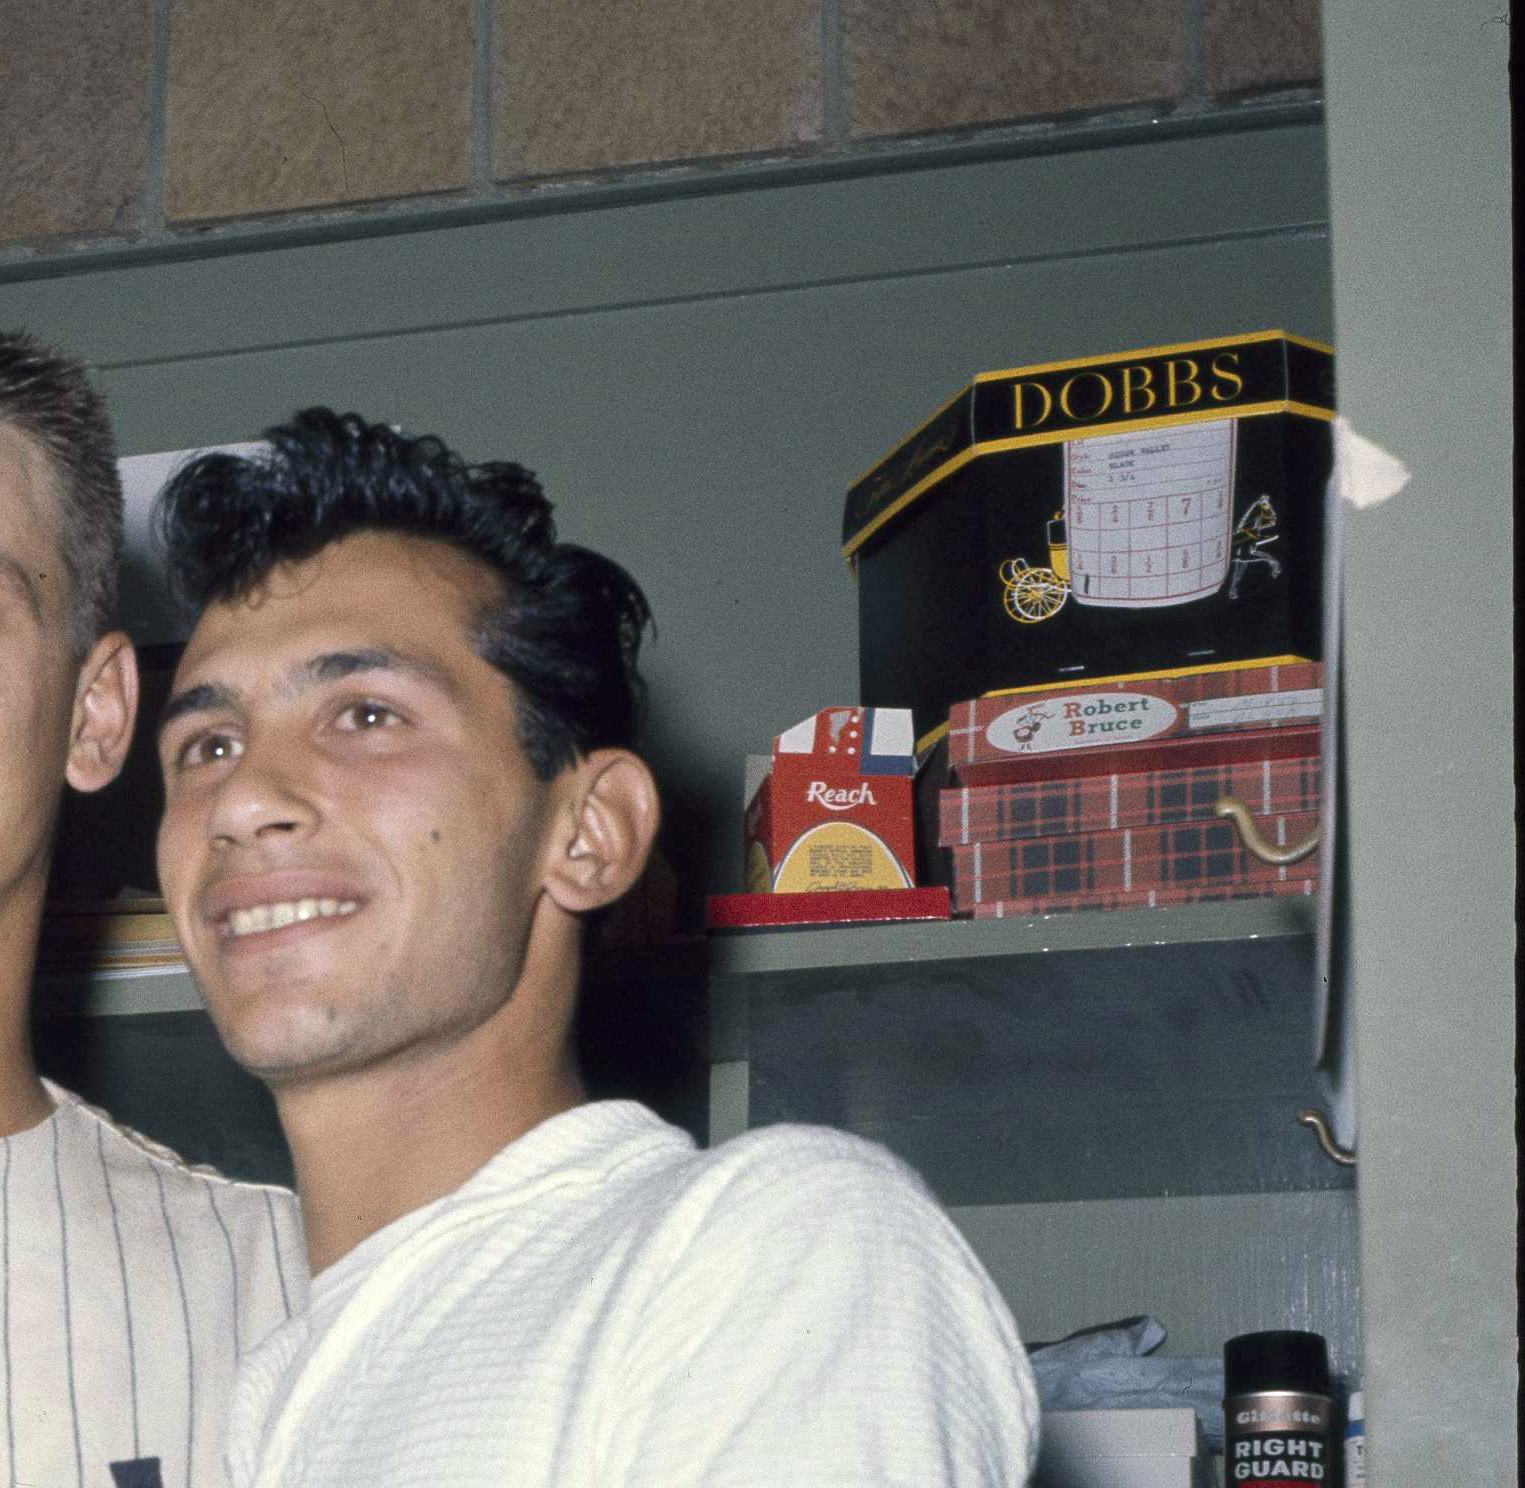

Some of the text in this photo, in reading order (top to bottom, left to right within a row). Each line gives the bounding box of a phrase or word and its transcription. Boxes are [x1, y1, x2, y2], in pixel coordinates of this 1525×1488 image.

[1011, 352, 1244, 430] DOBBS
[1062, 696, 1151, 720] Robert
[1068, 715, 1144, 738] Bruce
[806, 781, 878, 811] Reach
[1235, 1438, 1323, 1459] RIGHT
[1234, 1460, 1325, 1479] GUARD
